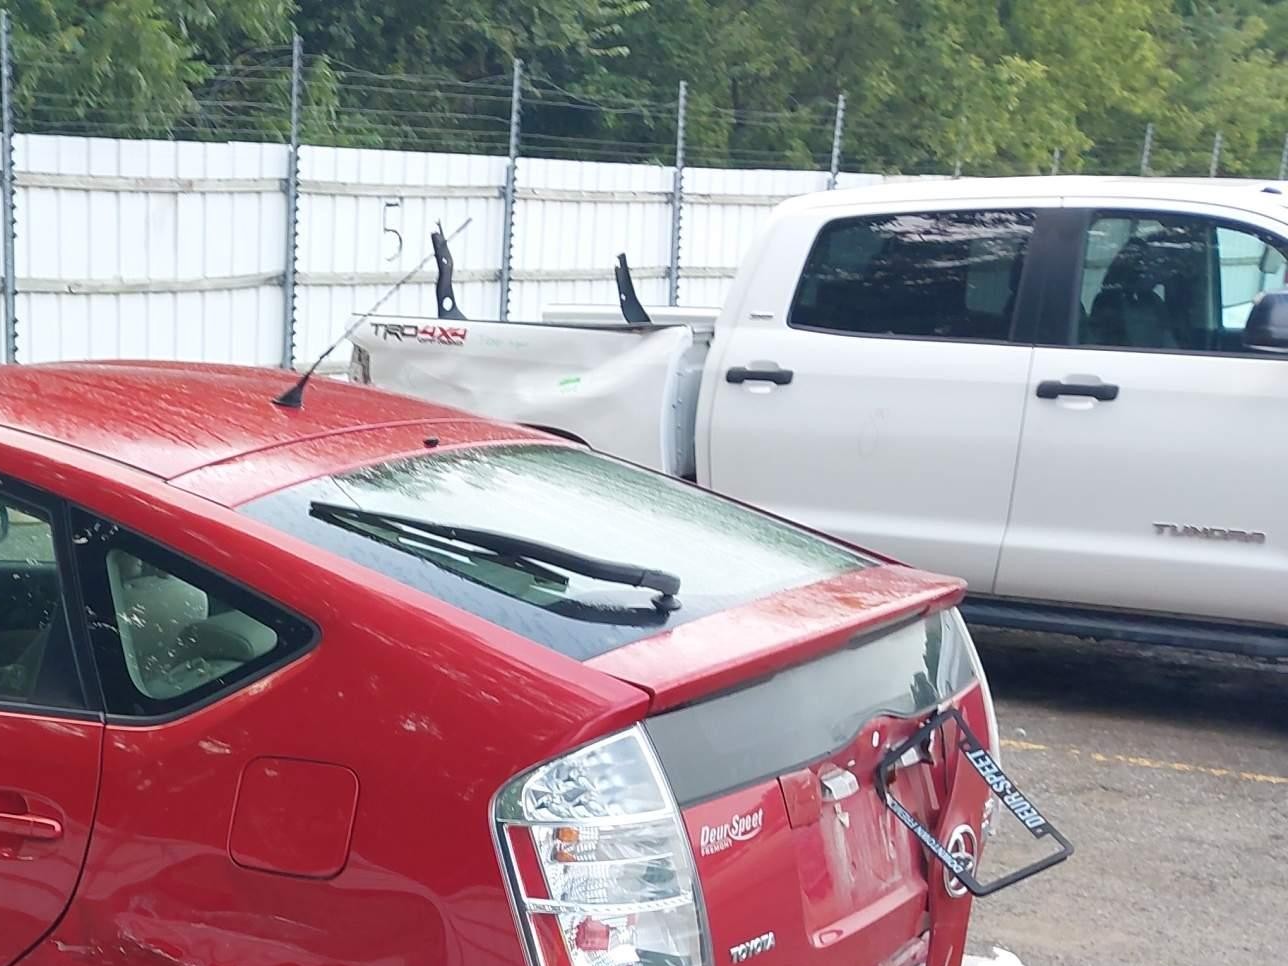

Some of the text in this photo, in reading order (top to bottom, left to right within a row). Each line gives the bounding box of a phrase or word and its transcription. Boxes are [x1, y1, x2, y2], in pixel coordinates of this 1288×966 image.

[383, 202, 403, 262] 5
[1153, 522, 1266, 544] TUNDRA
[966, 750, 1045, 829] DEUR-SPEET
[729, 932, 775, 964] TOYOTA
